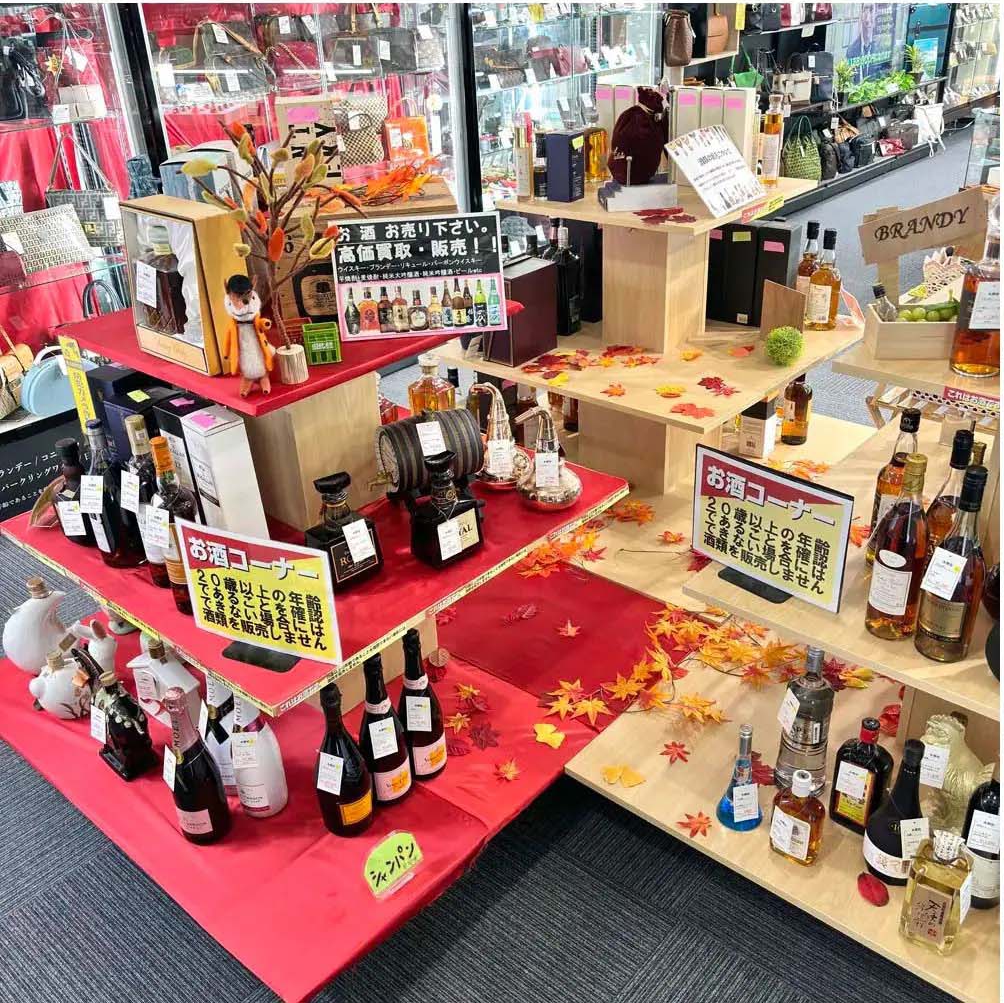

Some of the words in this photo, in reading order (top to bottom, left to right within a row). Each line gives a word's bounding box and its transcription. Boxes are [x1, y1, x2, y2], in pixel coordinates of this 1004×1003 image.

[874, 206, 970, 243] BRANDY
[706, 465, 836, 527] お酒コーナー
[188, 536, 320, 580] お酒コーナー
[704, 532, 825, 595] 酒類を販売しません
[204, 608, 328, 651] 酒類を販売しません
[370, 842, 414, 888] シャンパン
